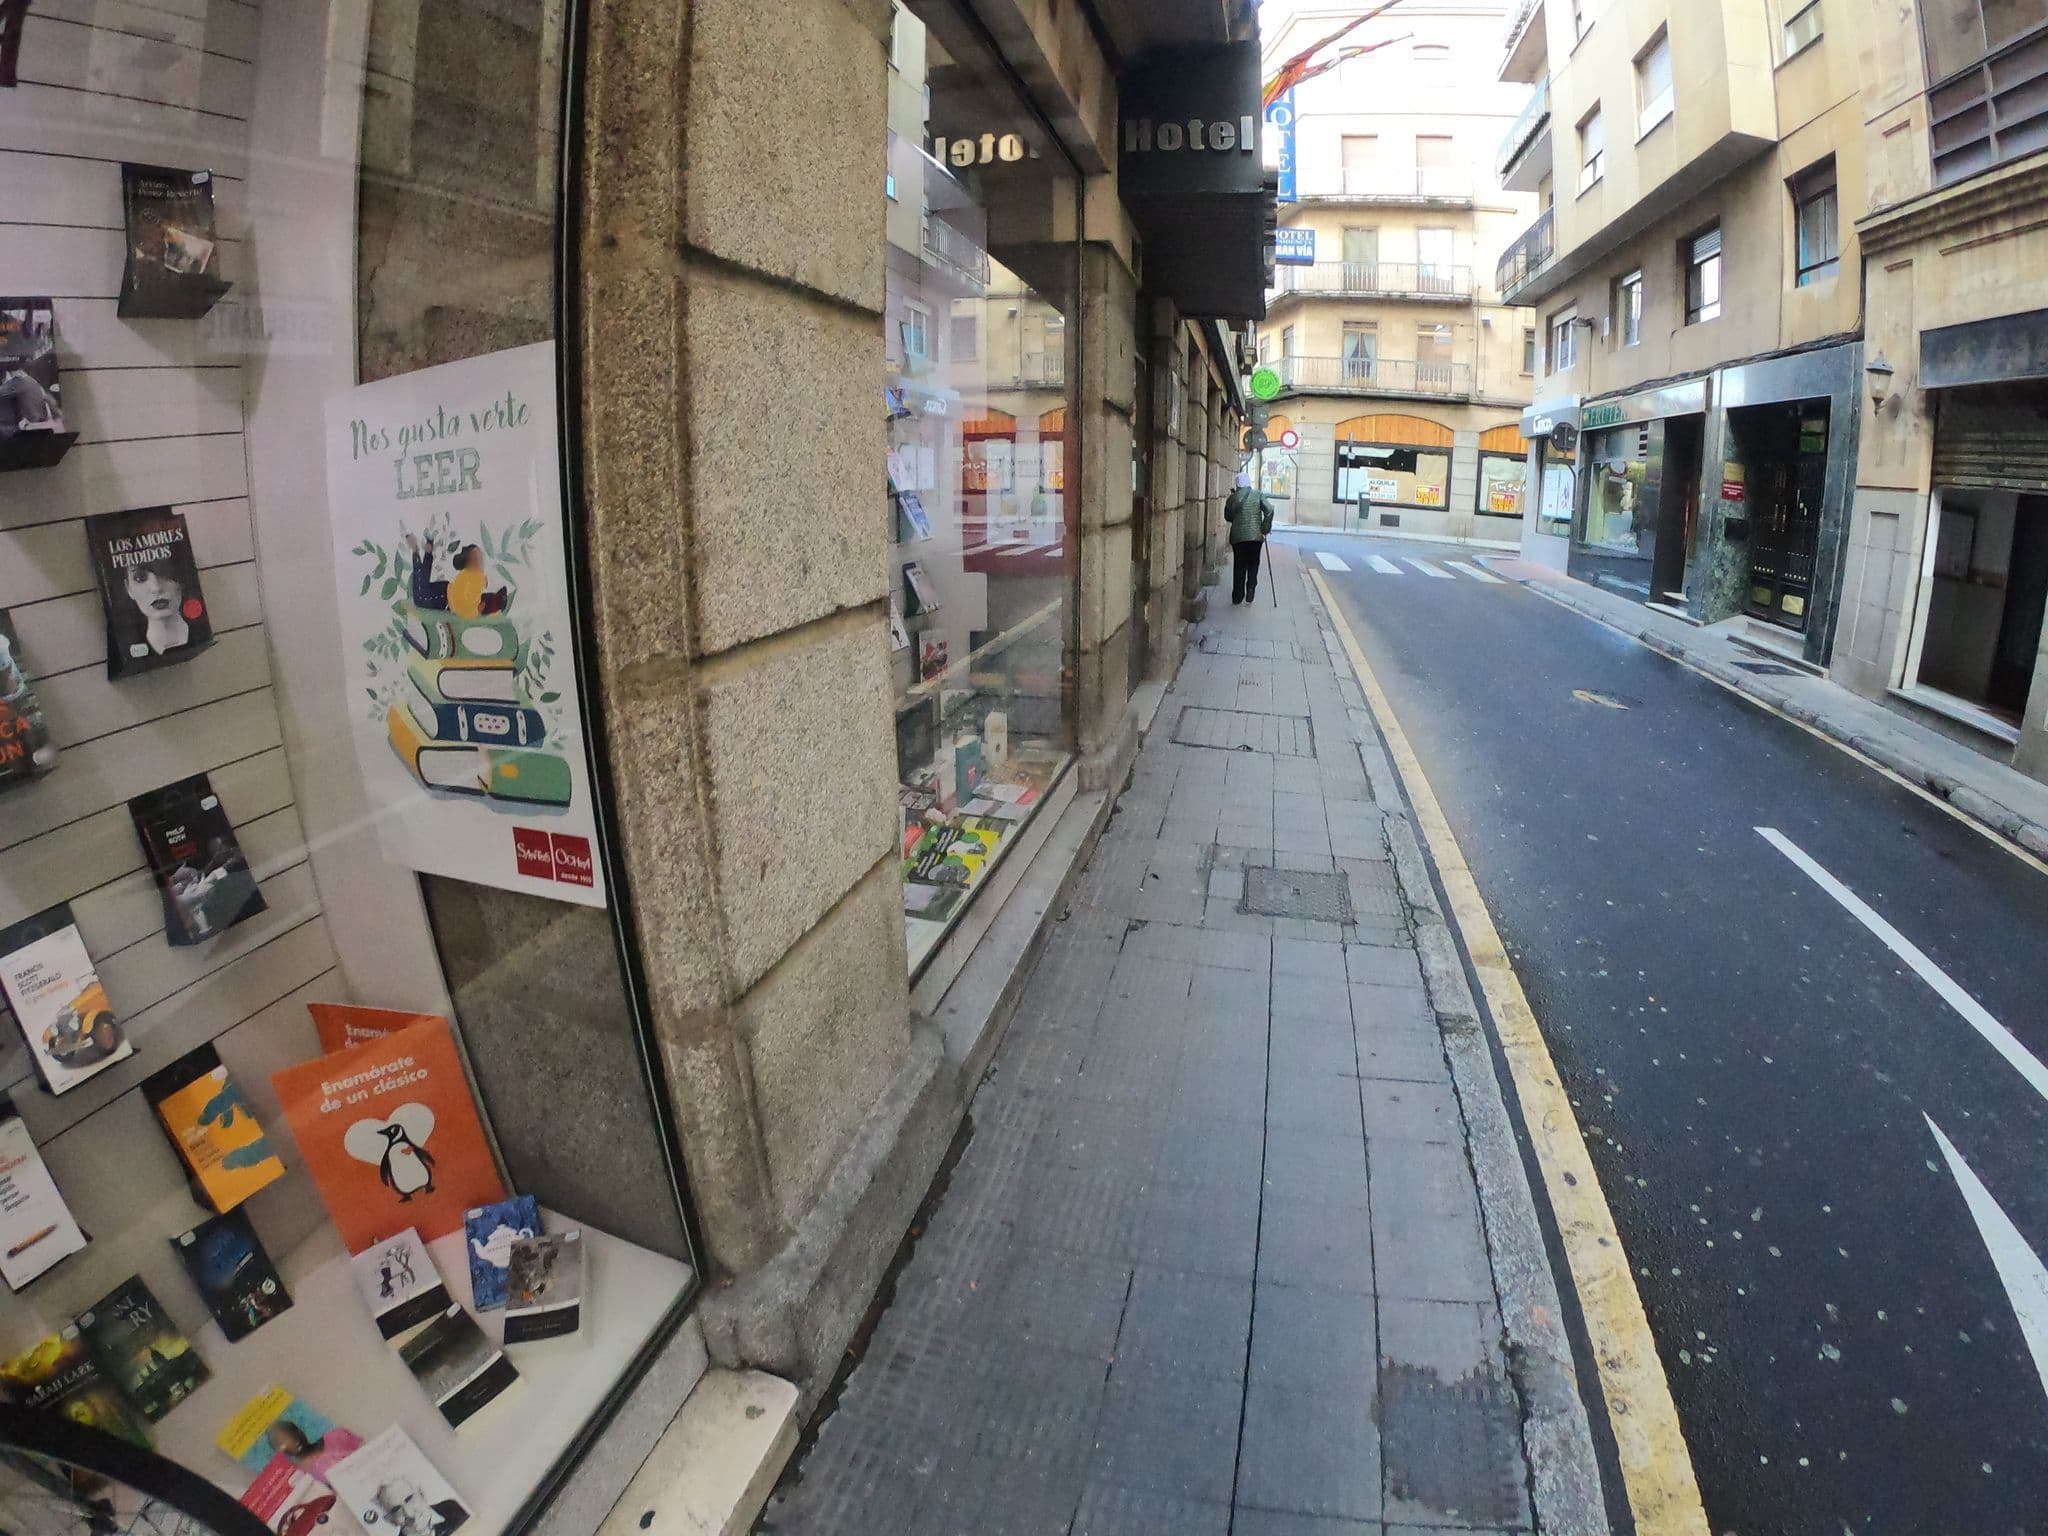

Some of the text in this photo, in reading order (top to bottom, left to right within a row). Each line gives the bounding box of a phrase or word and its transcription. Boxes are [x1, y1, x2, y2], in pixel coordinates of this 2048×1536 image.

[1125, 115, 1254, 152] Hotel
[1275, 245, 1295, 256] RAN
[350, 390, 531, 460] Nos gusta verte
[393, 447, 483, 500] LEER
[108, 527, 184, 554] LOS AMORES
[112, 545, 172, 569] PERDIDOS
[320, 1056, 414, 1096] Enamórate
[320, 1067, 428, 1113] de un clásico
